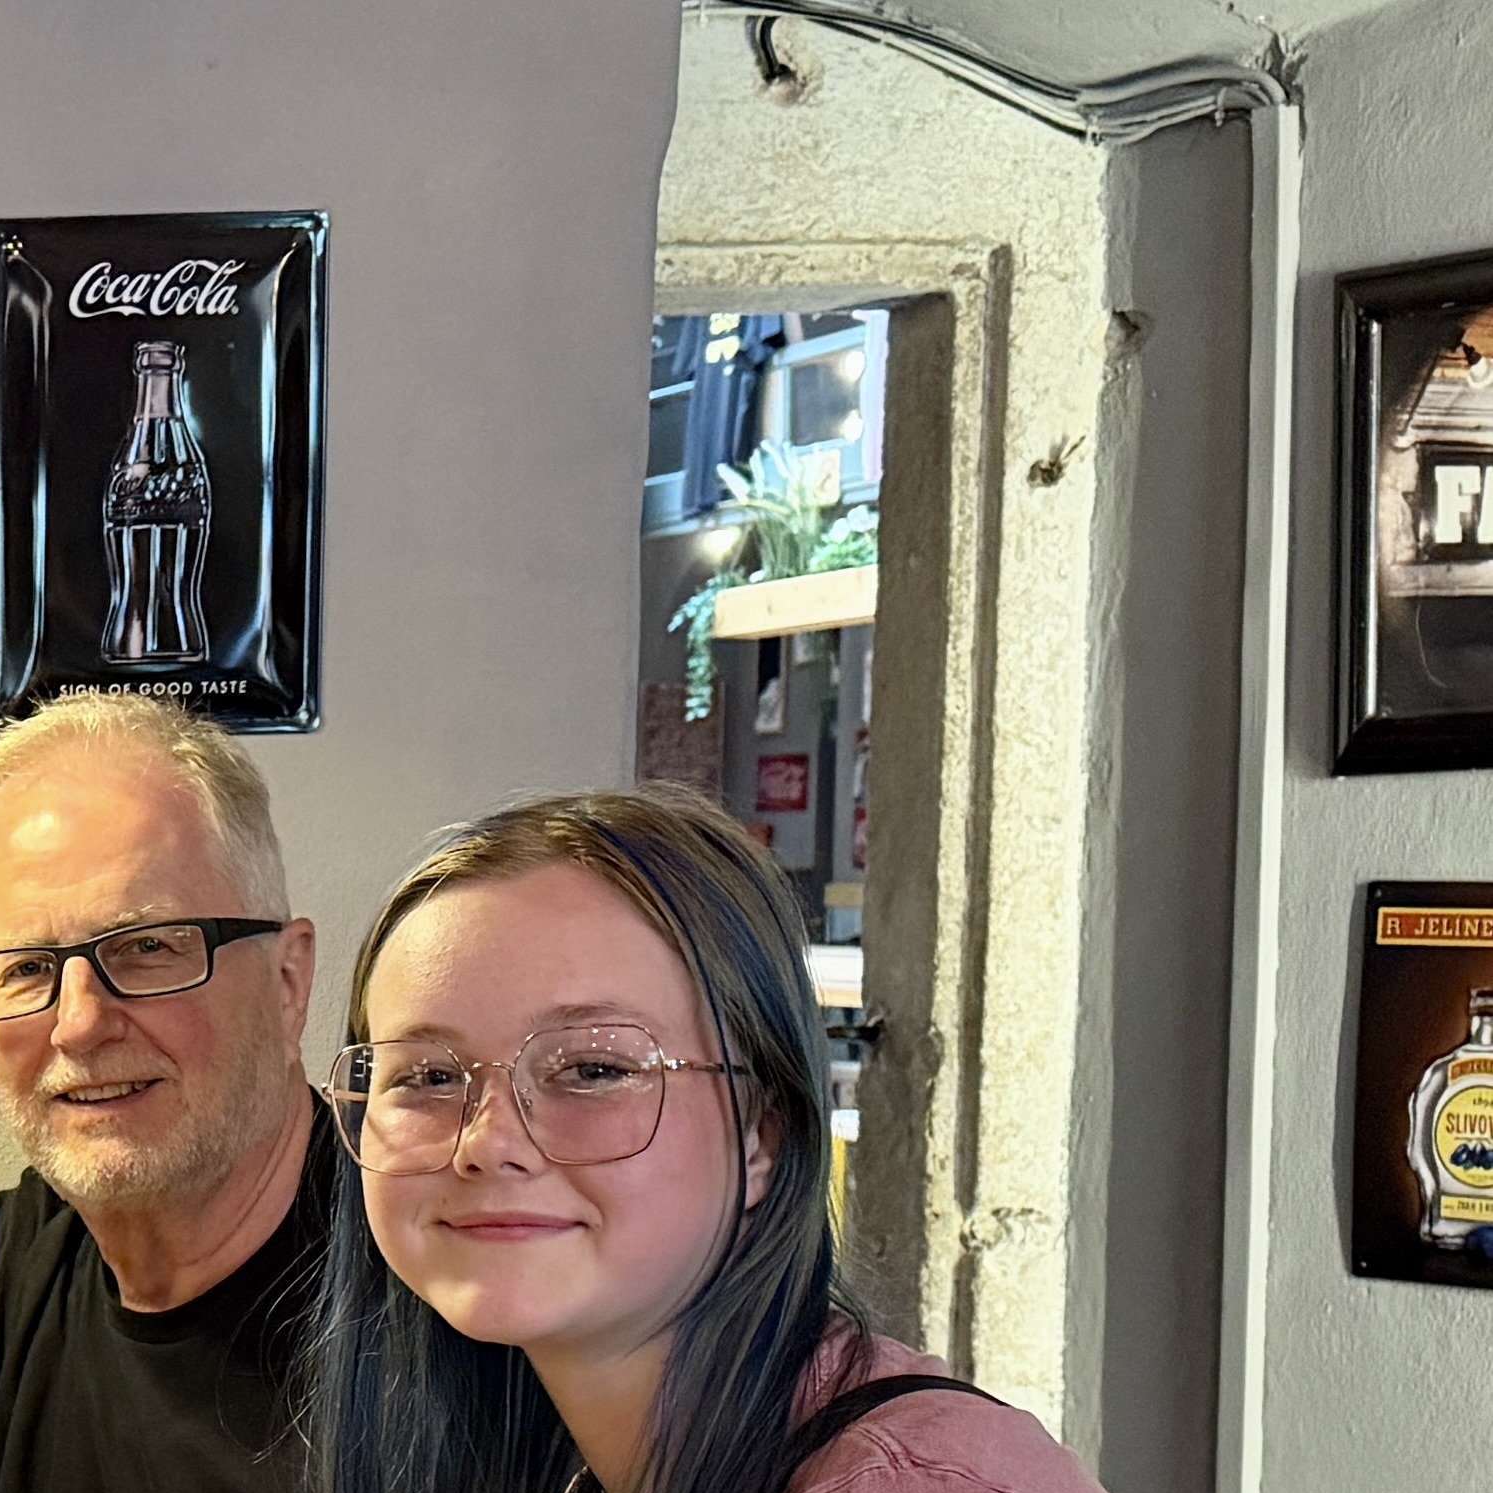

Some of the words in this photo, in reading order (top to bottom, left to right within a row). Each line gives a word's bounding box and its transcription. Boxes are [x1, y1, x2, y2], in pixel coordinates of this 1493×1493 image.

[69, 260, 246, 318] Coca-Cola
[59, 684, 100, 698] SIGN
[109, 683, 131, 696] OF
[139, 681, 192, 696] GOOD
[201, 680, 247, 694] TASTE
